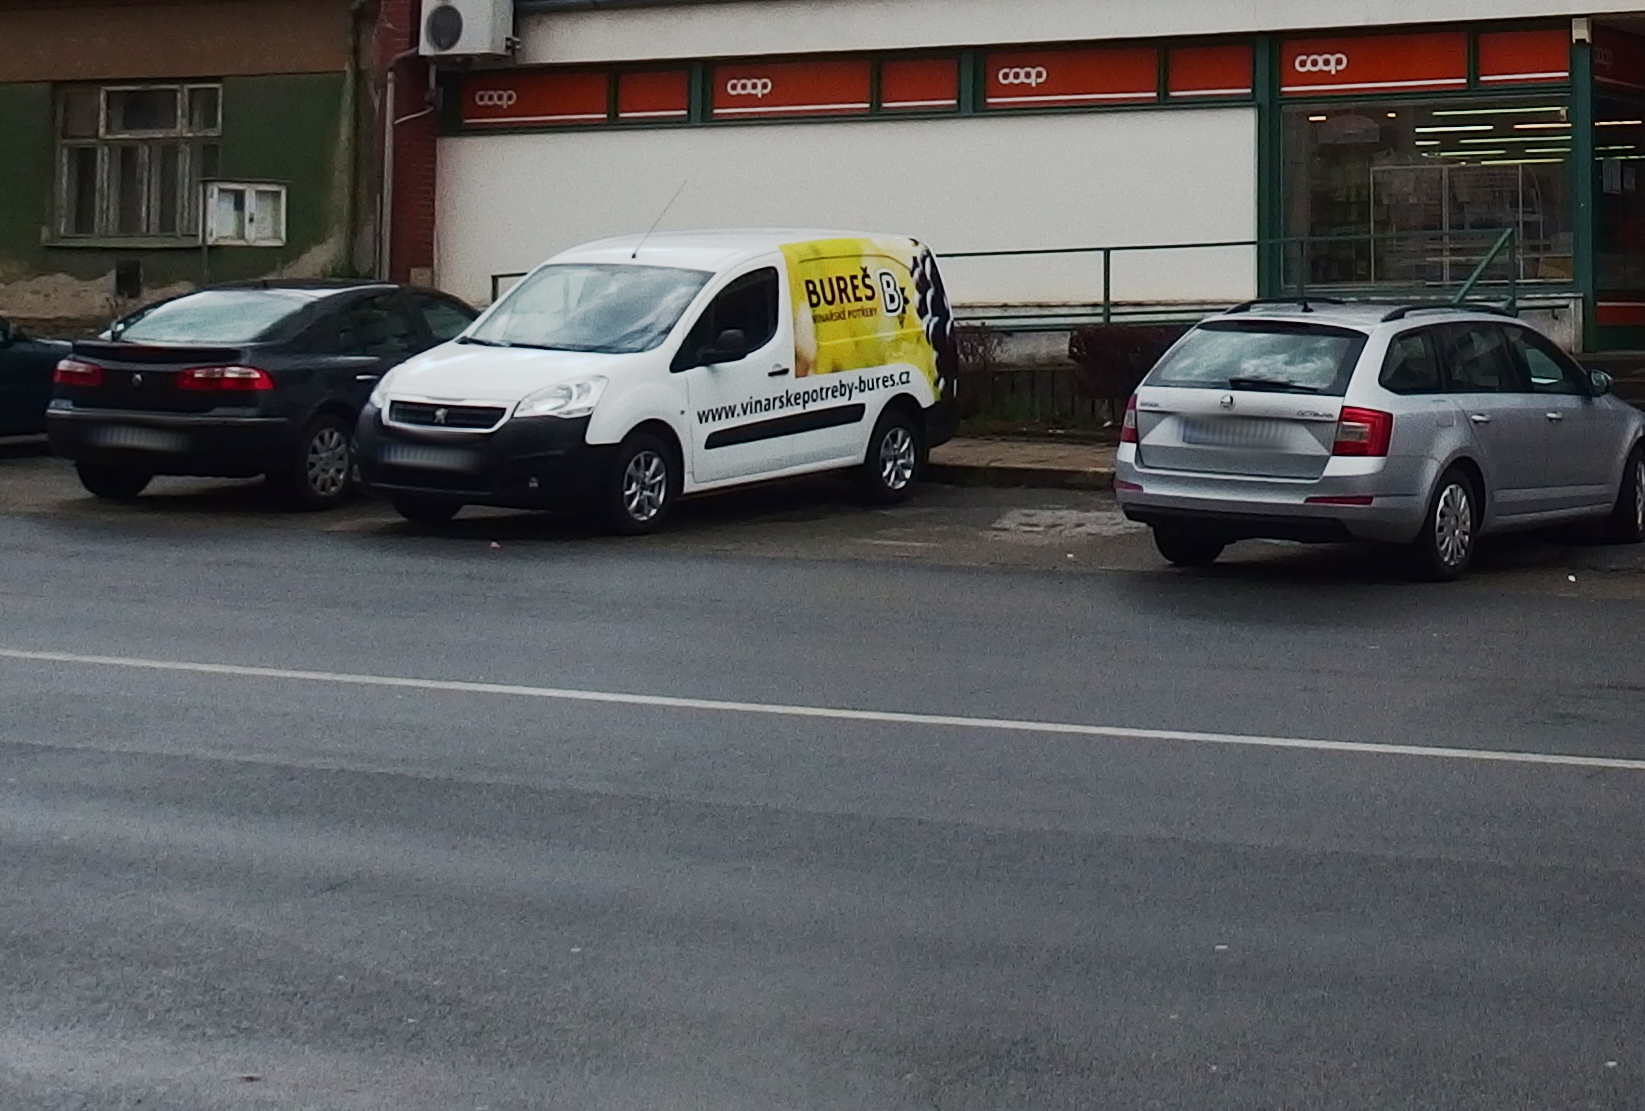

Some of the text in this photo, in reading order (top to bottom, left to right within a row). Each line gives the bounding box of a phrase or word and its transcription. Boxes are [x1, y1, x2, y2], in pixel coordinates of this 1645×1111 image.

[1294, 52, 1347, 75] coop
[726, 76, 772, 97] coop
[998, 65, 1047, 87] coop
[474, 89, 517, 108] coop
[804, 266, 876, 308] BUREŠ
[697, 370, 912, 424] www.vinarskepotreby-bures.cz
